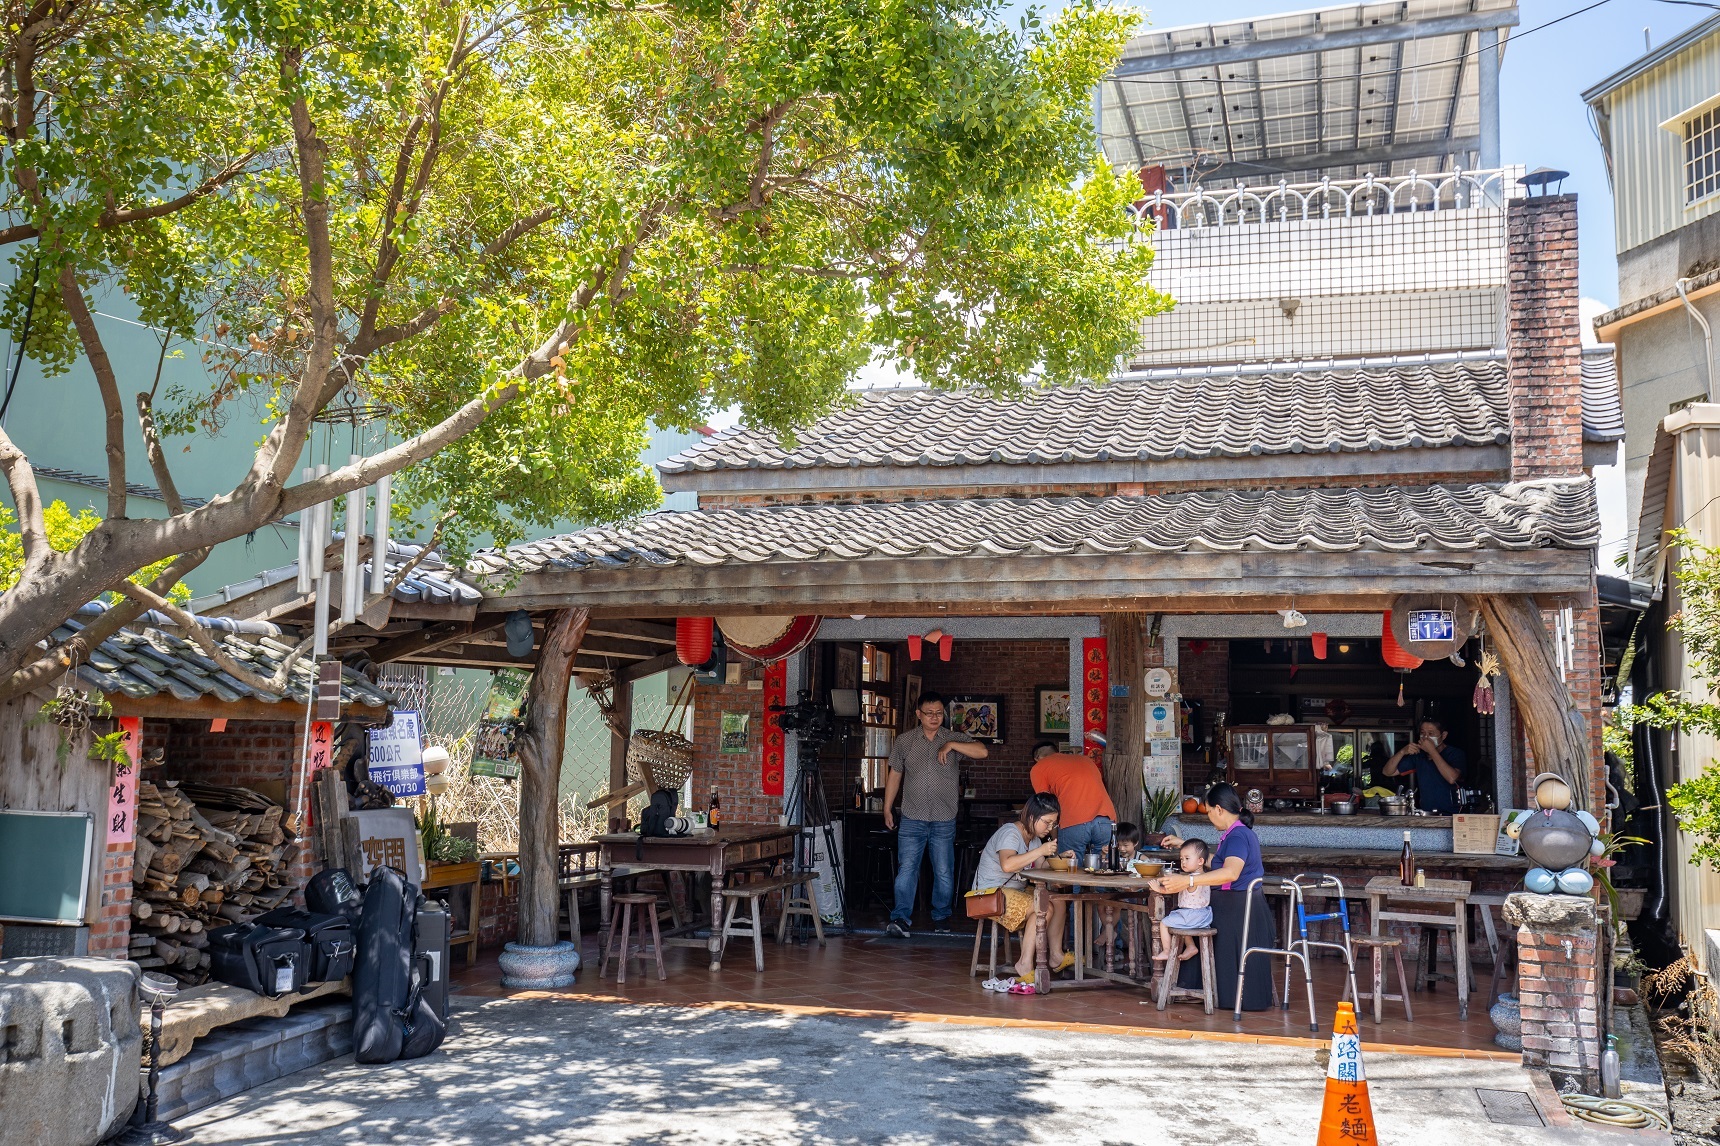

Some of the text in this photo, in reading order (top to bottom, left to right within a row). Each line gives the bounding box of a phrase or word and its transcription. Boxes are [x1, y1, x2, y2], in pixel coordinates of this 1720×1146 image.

[1419, 613, 1450, 621] 中正路
[386, 782, 418, 794] 00730
[361, 836, 407, 879] 空間
[1337, 1019, 1368, 1146] 大路關老麵
